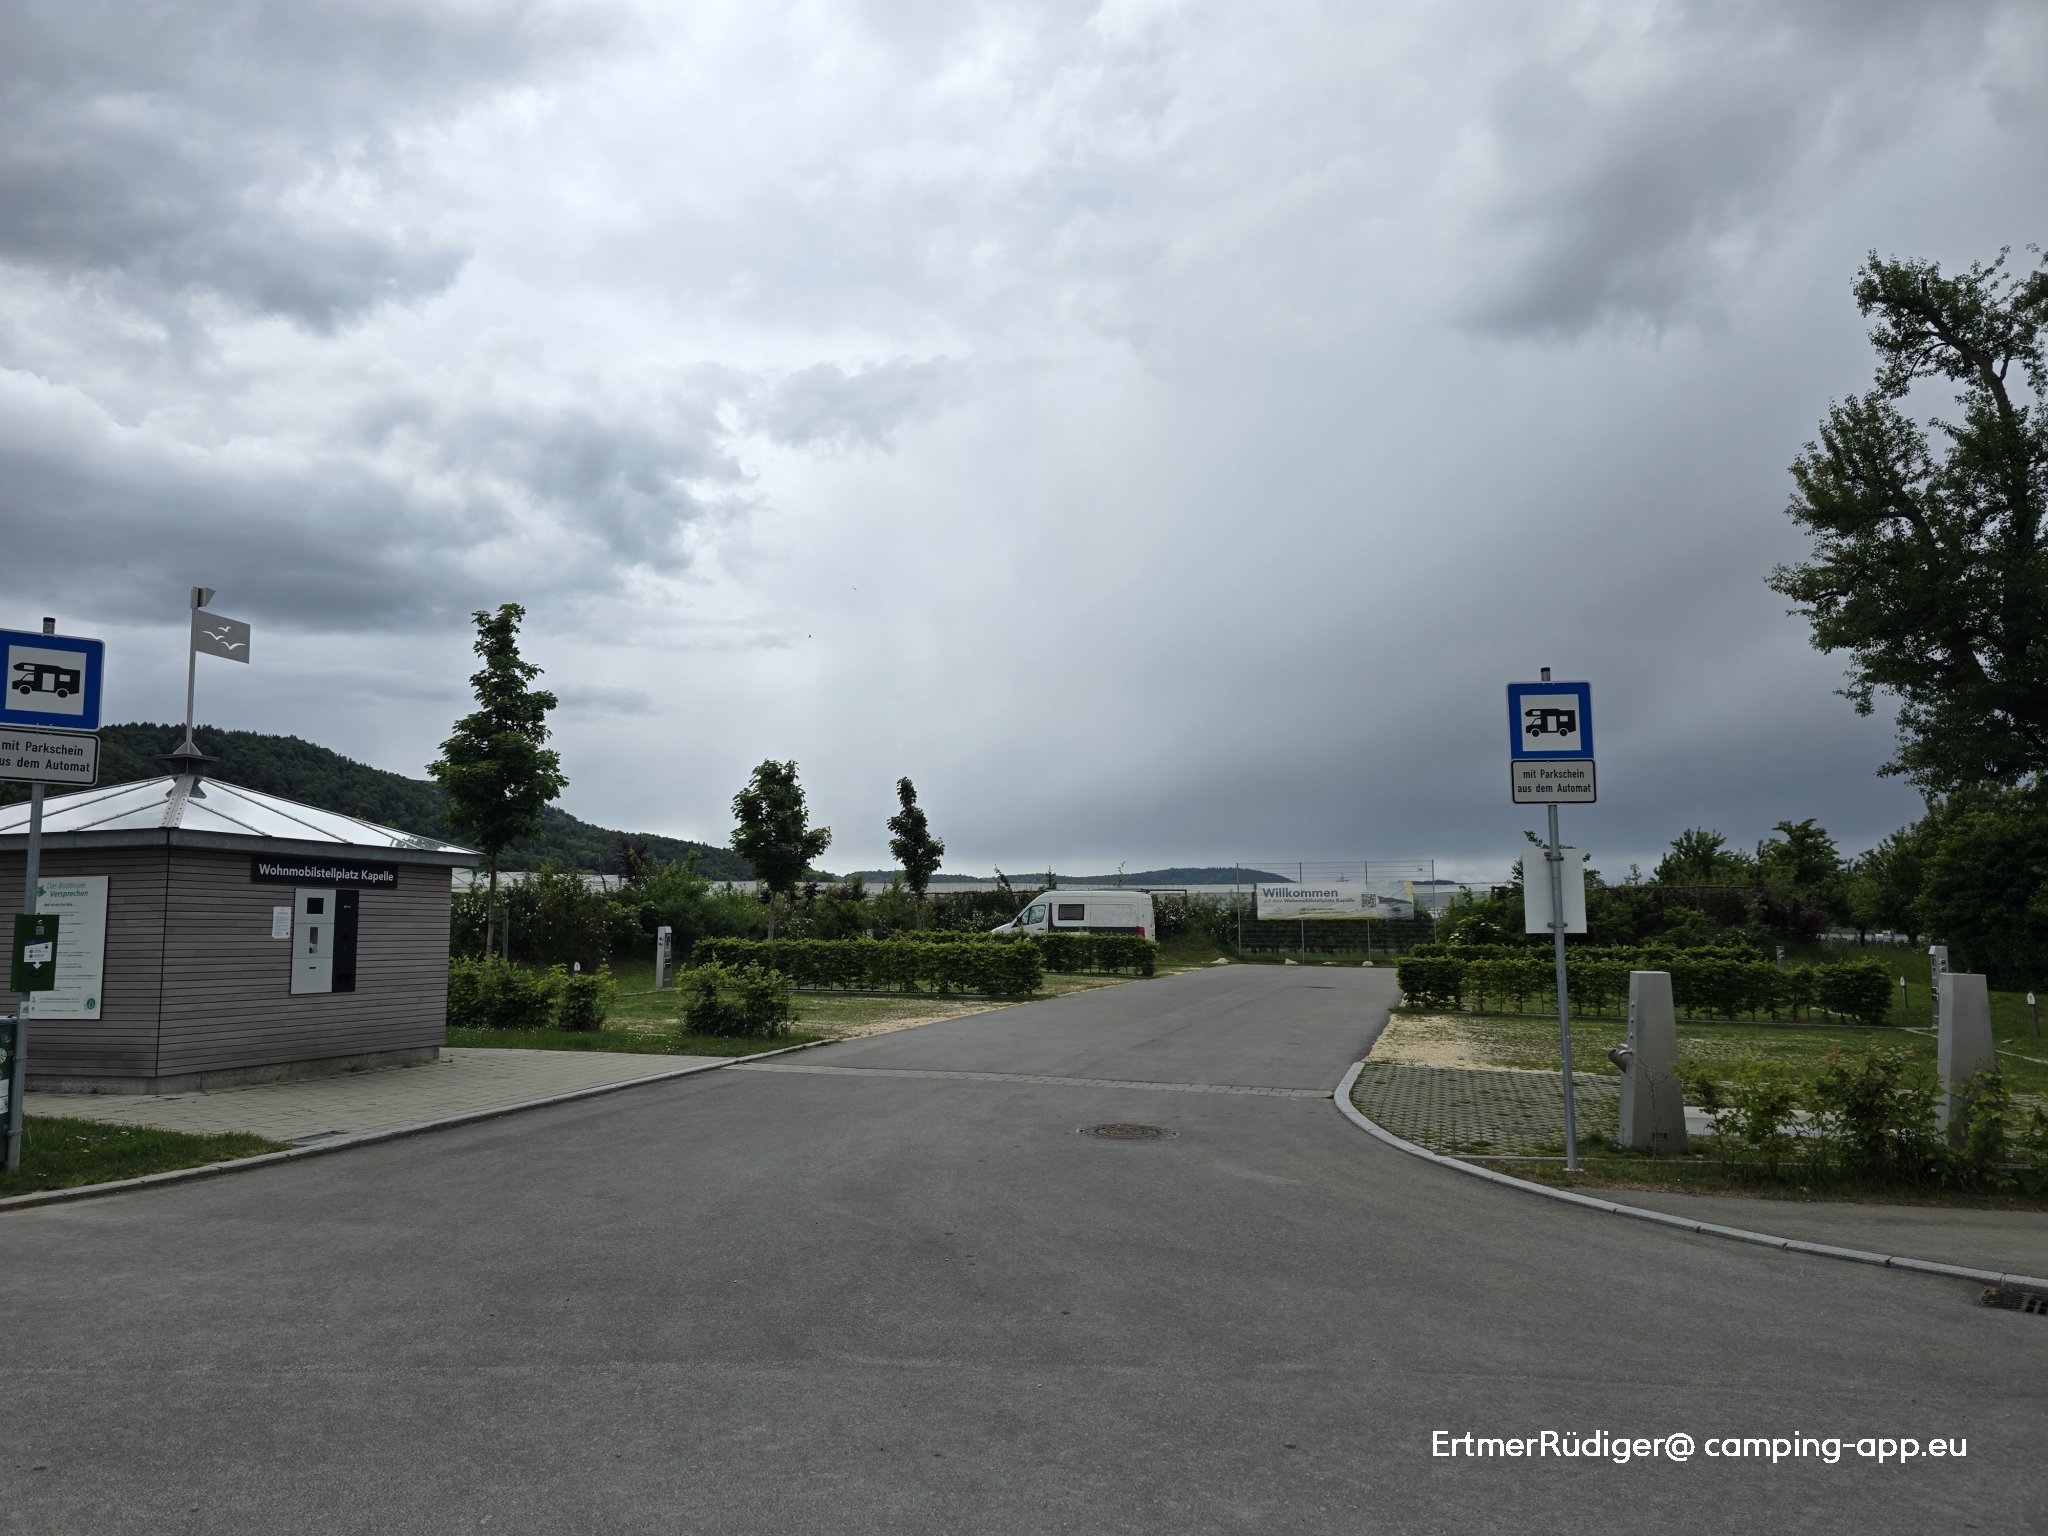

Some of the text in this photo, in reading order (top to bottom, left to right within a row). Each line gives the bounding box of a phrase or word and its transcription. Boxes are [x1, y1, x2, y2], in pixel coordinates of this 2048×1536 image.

[2, 740, 83, 756] mit Parkschein
[0, 757, 90, 773] us dem Automat
[1523, 769, 1585, 779] mit Parkschein
[1535, 784, 1553, 793] dem
[1557, 783, 1591, 793] Automat
[259, 863, 394, 883] Wohnmobilstellplatz Kapelle
[50, 889, 89, 898] Versprechen
[1262, 887, 1338, 898] Willkommen
